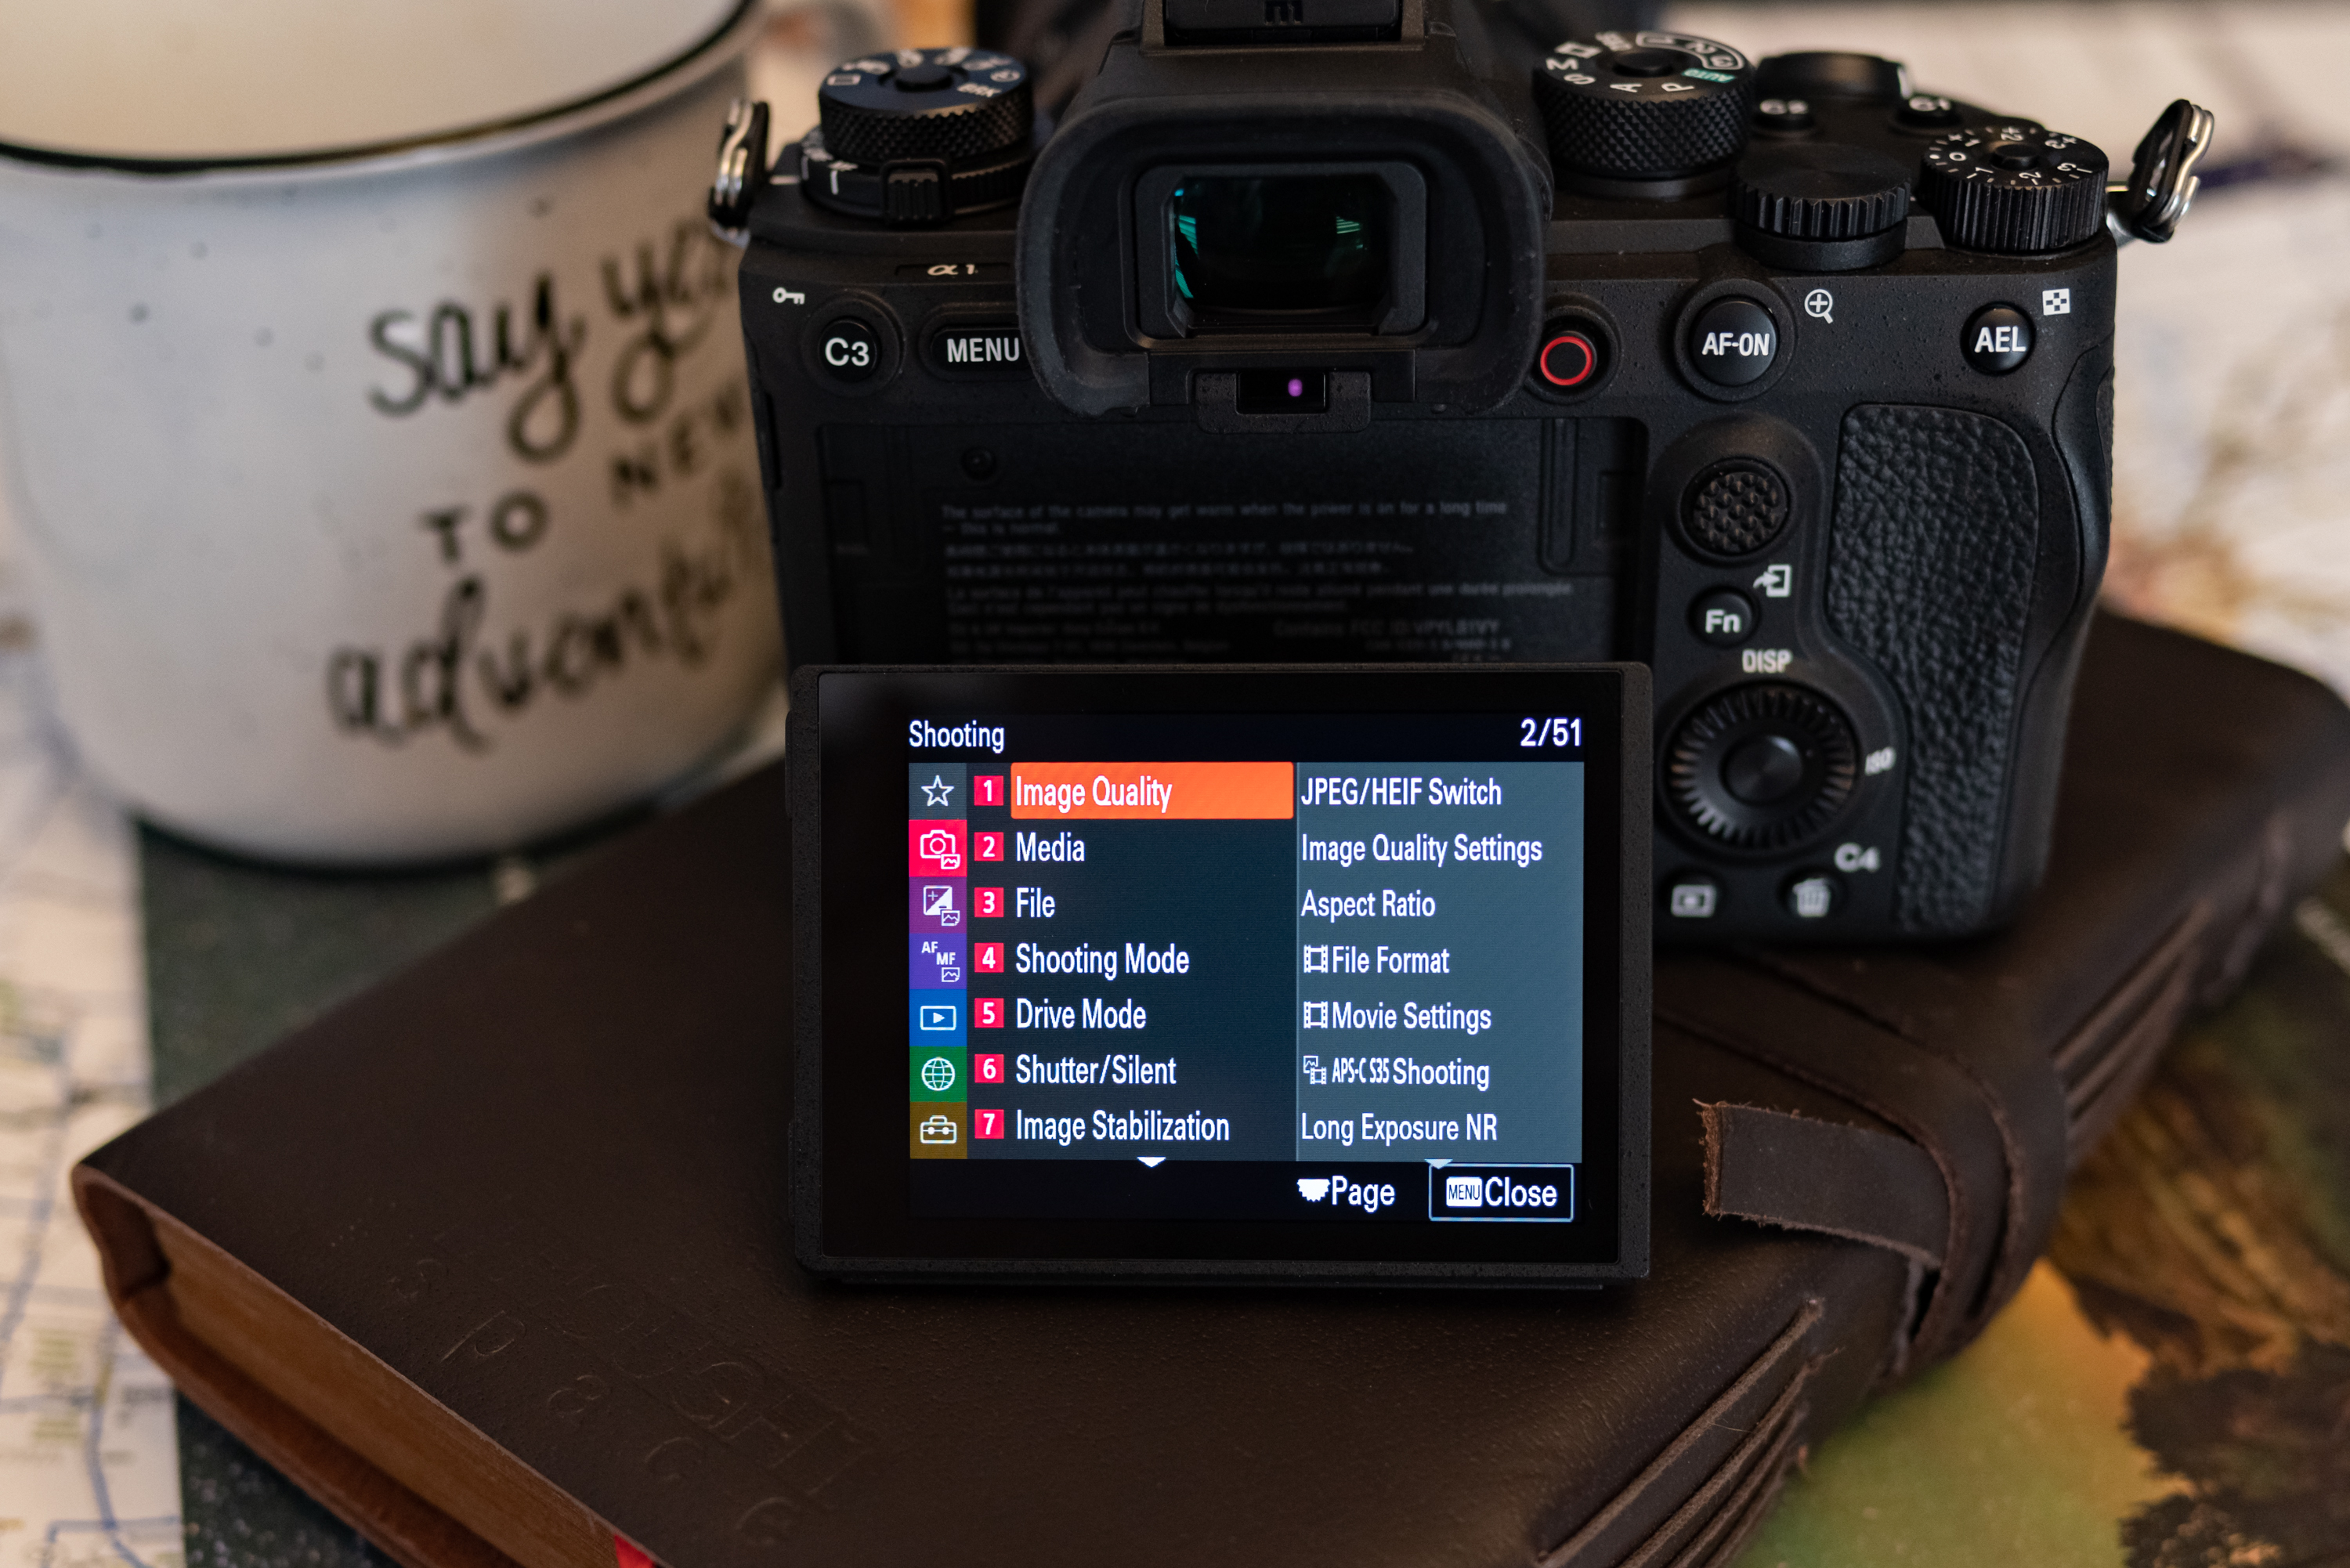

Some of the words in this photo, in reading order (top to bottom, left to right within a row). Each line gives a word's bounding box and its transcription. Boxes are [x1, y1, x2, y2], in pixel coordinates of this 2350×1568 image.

[823, 336, 871, 367] C3
[946, 337, 1020, 363] MENU
[1701, 331, 1772, 359] AF-ON
[1973, 325, 2027, 354] AEL
[1705, 609, 1742, 634] Fn
[1741, 648, 1793, 674] DISP
[909, 720, 1004, 754] Shooting
[1520, 718, 1580, 746] 2/51
[983, 779, 992, 802] 1
[1016, 775, 1086, 814] Image
[1092, 775, 1173, 814] Quality
[1300, 777, 1423, 805] JPEG/HEIF
[1428, 777, 1502, 805] Switch
[982, 836, 996, 858] 2
[1016, 832, 1085, 862] Media
[1302, 833, 1366, 868] Image
[1372, 833, 1448, 868] Quality
[1454, 833, 1542, 868] Settings
[1833, 842, 1881, 873] C4
[982, 891, 996, 914] 3
[1016, 887, 1055, 918] File
[1300, 889, 1376, 923] Aspect
[1382, 889, 1436, 917] Ratio
[982, 946, 996, 969] 4
[1015, 942, 1117, 981] Shooting
[1126, 942, 1190, 974] Mode
[1332, 945, 1370, 974] File
[1377, 945, 1450, 974] Format
[982, 1002, 996, 1024] 5
[1017, 998, 1076, 1028] Drive
[1082, 998, 1147, 1029] Mode
[1332, 1001, 1397, 1029] Movie
[1403, 1001, 1491, 1035] Settings
[982, 1057, 996, 1079] 6
[1016, 1053, 1177, 1085] Shutter/Silent
[1392, 1057, 1490, 1092] Shooting
[983, 1113, 996, 1136] 7
[1017, 1109, 1086, 1147] Image
[1092, 1109, 1230, 1141] Stabilization
[1301, 1112, 1354, 1147] Long
[1361, 1112, 1459, 1147] Exposure
[1466, 1113, 1497, 1141] NR
[1332, 1175, 1395, 1213] Page
[1447, 1183, 1480, 1201] MENU
[1484, 1176, 1557, 1207] Close
